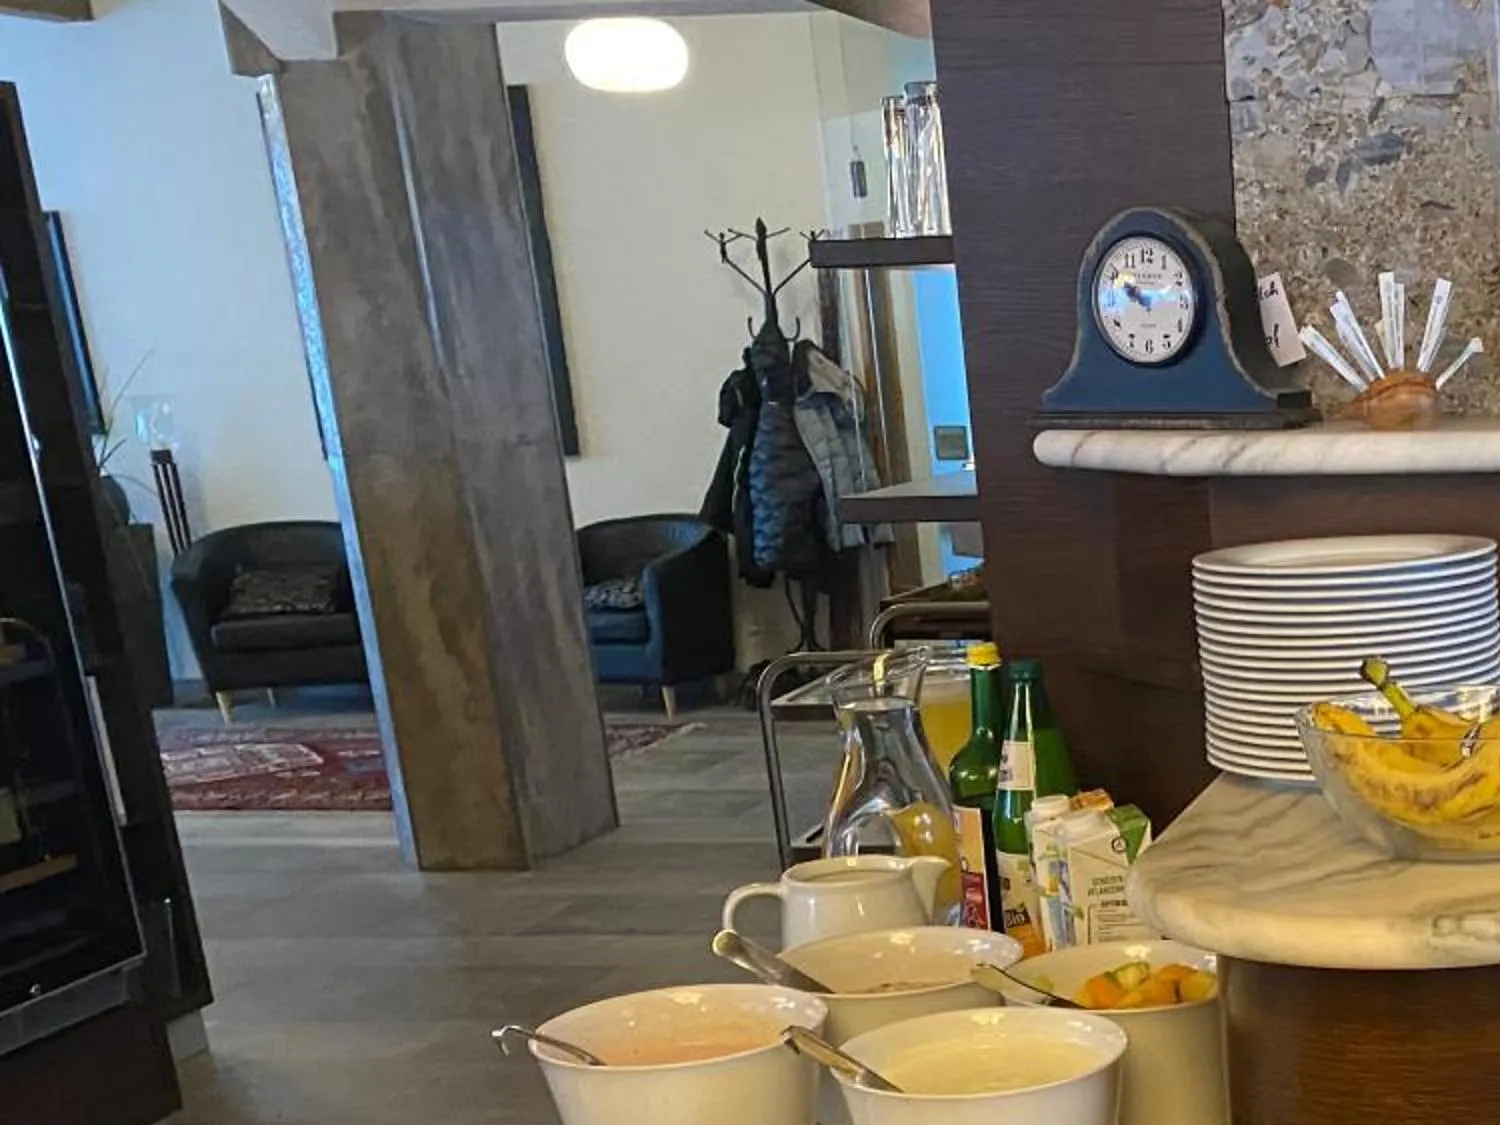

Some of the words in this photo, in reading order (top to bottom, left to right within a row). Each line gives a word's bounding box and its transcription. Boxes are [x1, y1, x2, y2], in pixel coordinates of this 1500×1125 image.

[1124, 252, 1136, 269] 11
[1141, 247, 1153, 264] 12
[1144, 339, 1154, 354] 6
